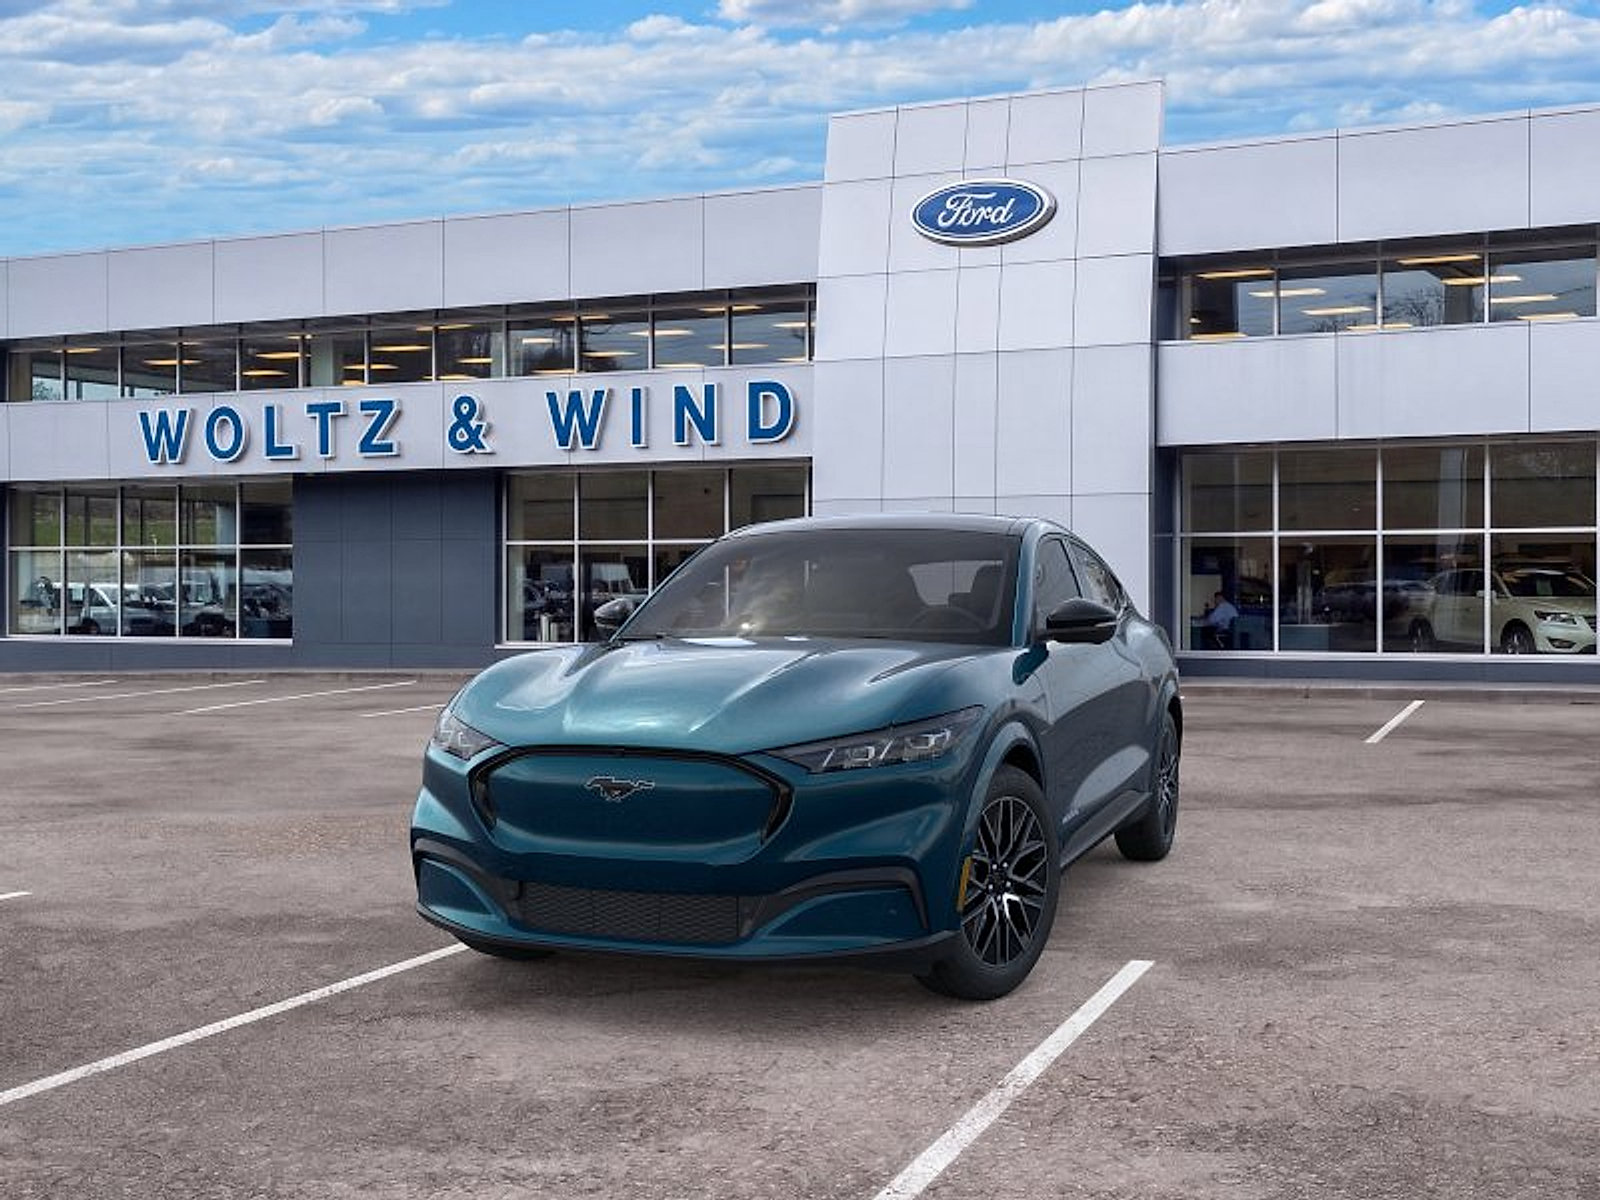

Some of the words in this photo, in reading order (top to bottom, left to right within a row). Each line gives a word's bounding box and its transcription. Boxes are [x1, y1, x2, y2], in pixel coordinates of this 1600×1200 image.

[937, 191, 1016, 228] Ford
[138, 399, 401, 464] WOLTZ
[448, 395, 490, 454] &
[546, 379, 795, 450] WIND
